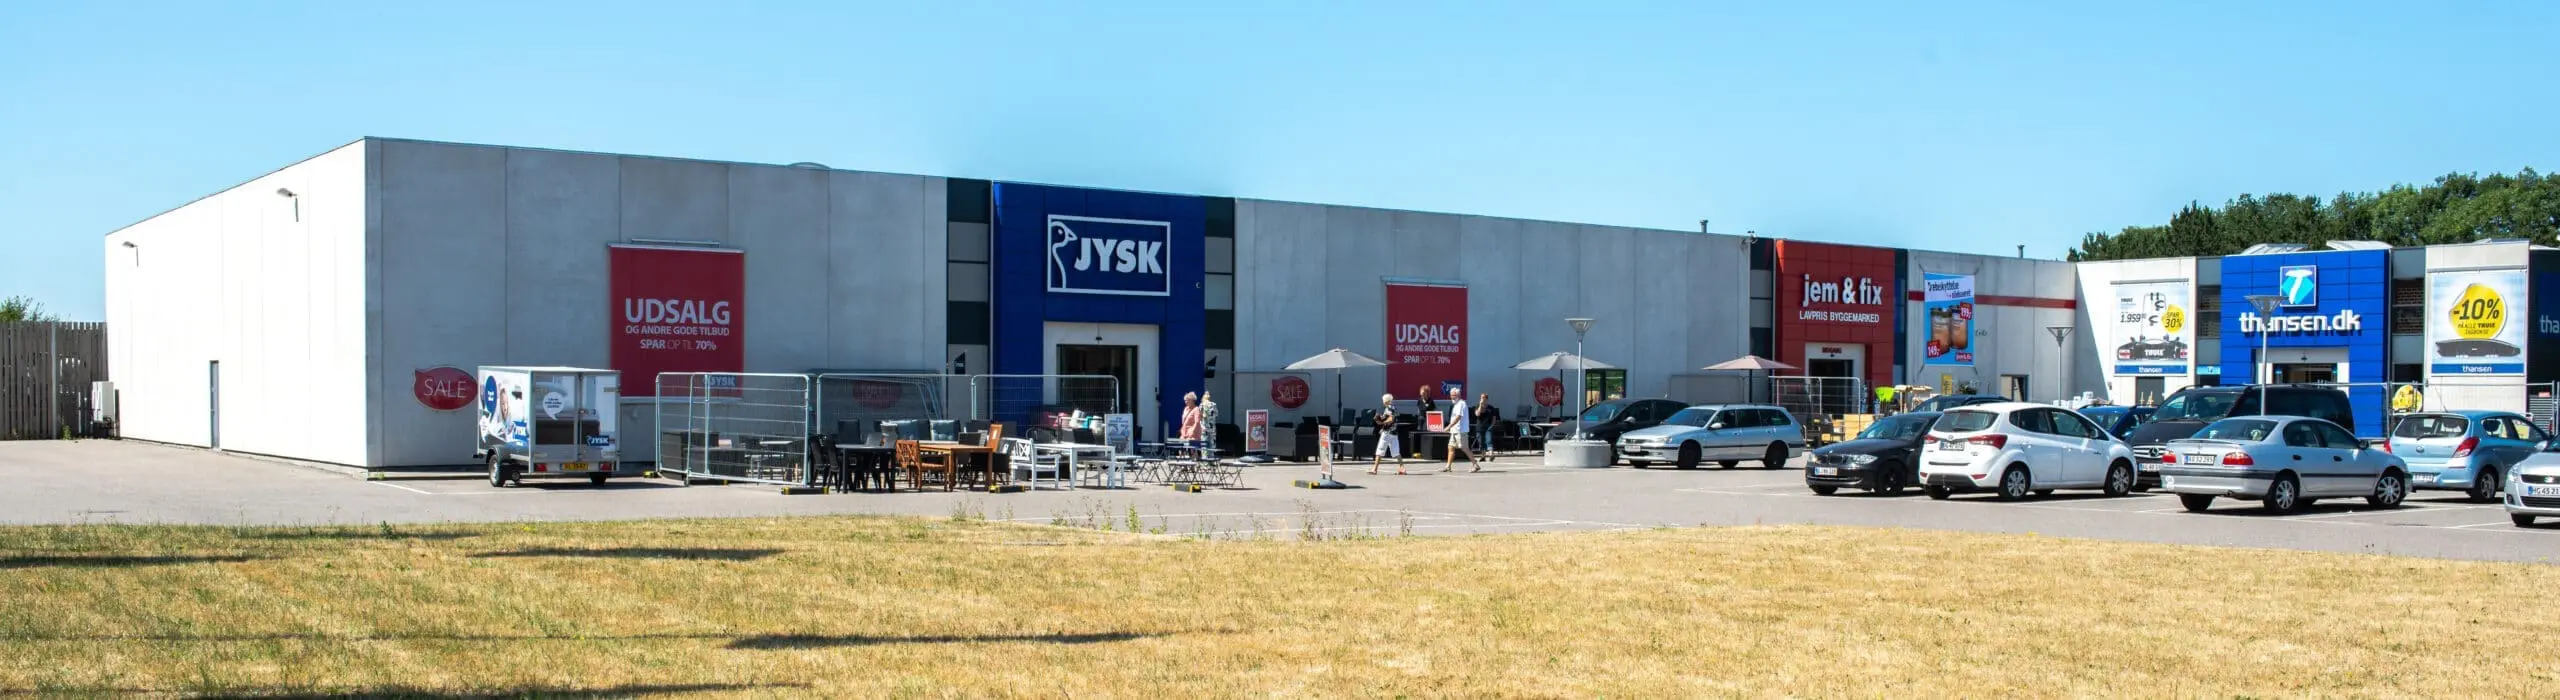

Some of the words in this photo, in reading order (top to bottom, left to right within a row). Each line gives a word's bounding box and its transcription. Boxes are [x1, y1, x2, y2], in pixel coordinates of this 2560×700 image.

[1074, 237, 1163, 274] JYSK
[1803, 273, 1838, 307] jem
[1842, 277, 1856, 304] &
[1860, 277, 1882, 305] fix
[625, 298, 730, 325] UDSALG
[2453, 298, 2500, 320] -10%
[1799, 310, 1828, 321] LAVPRIS
[1830, 311, 1880, 323] BYGGEMARKED
[2239, 309, 2361, 332] thansen.dk
[2165, 318, 2182, 329] 30%
[625, 324, 640, 335] OG
[641, 325, 672, 335] ANDRE
[673, 326, 699, 336] GODE
[699, 327, 730, 337] TILBUD
[1395, 324, 1460, 344] UDSALG
[640, 339, 666, 350] SPAR
[667, 341, 680, 351] OP
[695, 341, 718, 351] 70%
[1404, 344, 1424, 353] ANDRE
[1424, 345, 1440, 353] GODE
[1440, 345, 1460, 353] TILBUD
[1404, 355, 1420, 364] SPAR
[1437, 356, 1451, 365] 70%
[2138, 366, 2163, 374] thansen
[2462, 365, 2492, 373] thansen
[423, 378, 467, 398] SALE
[1276, 384, 1304, 400] SALE
[591, 436, 610, 445] JYSK
